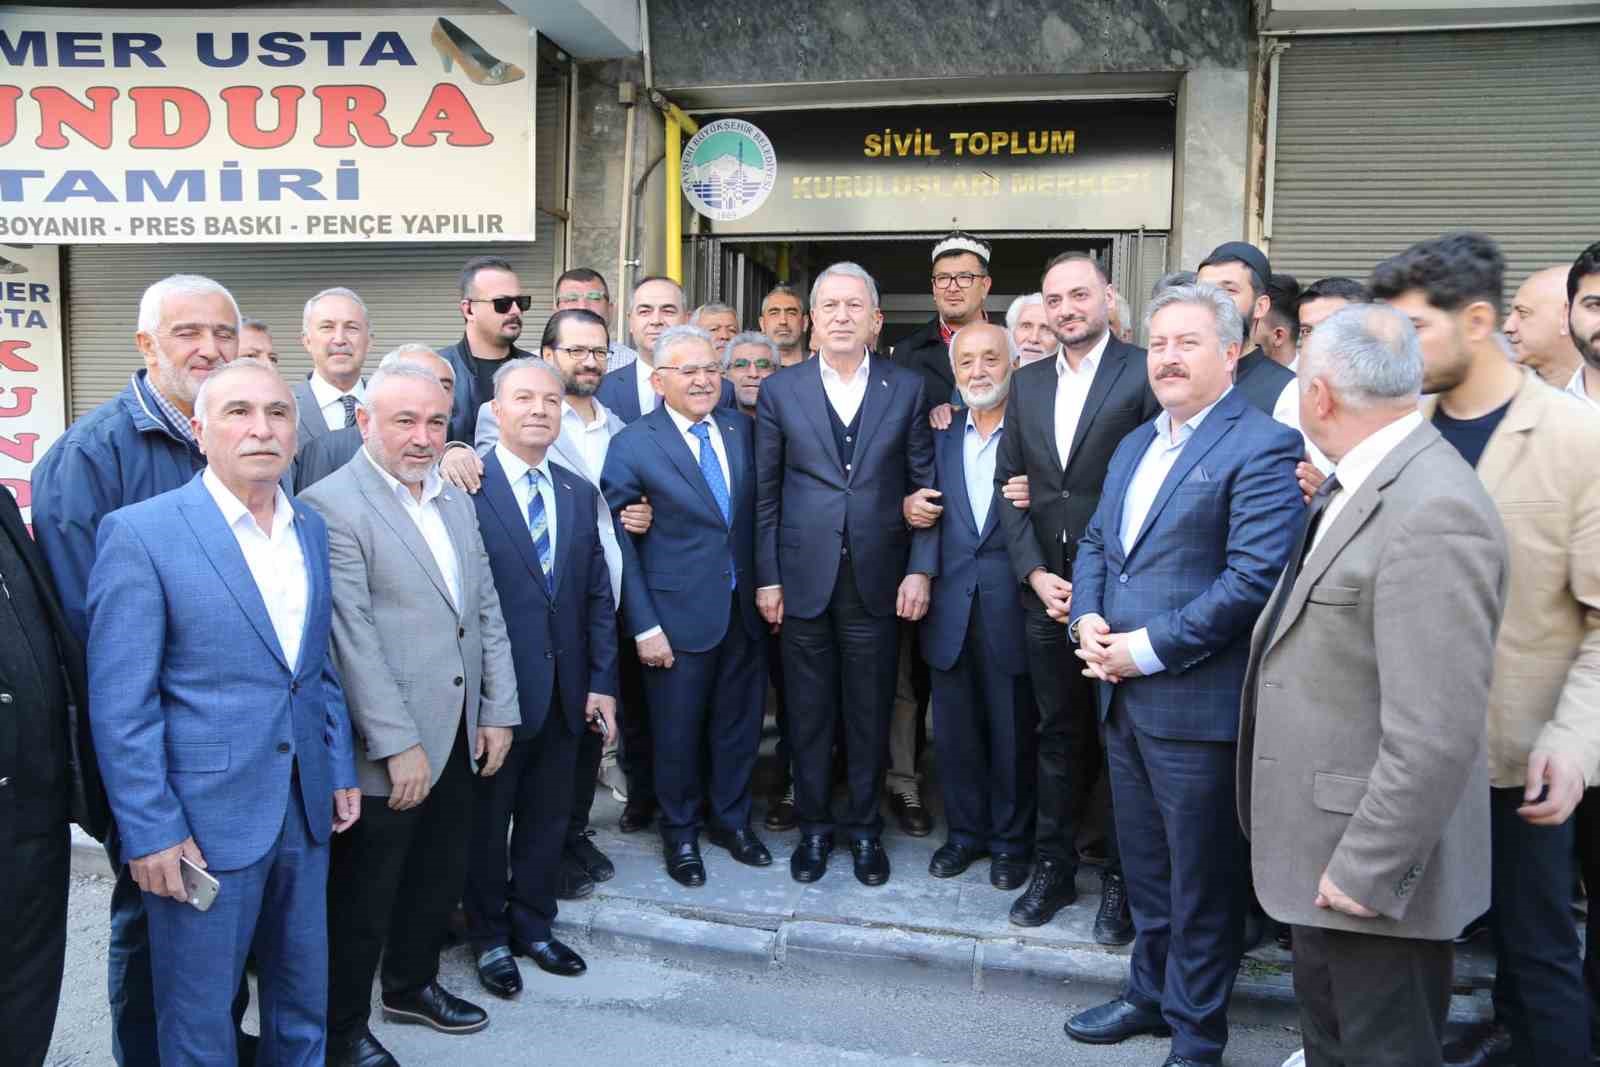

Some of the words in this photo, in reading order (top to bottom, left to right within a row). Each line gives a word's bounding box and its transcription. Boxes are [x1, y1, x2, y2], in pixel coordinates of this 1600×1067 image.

[196, 31, 417, 67] USTA
[864, 128, 941, 157] SİVİL
[950, 131, 1075, 156] TOPLUM
[0, 159, 361, 203] TAMİRİ
[130, 217, 195, 235] PRES
[205, 216, 282, 236] BASKI
[306, 215, 392, 239] PENÇE
[401, 214, 504, 235] YAPILIR
[0, 282, 51, 303] ER
[0, 308, 48, 329] TA
